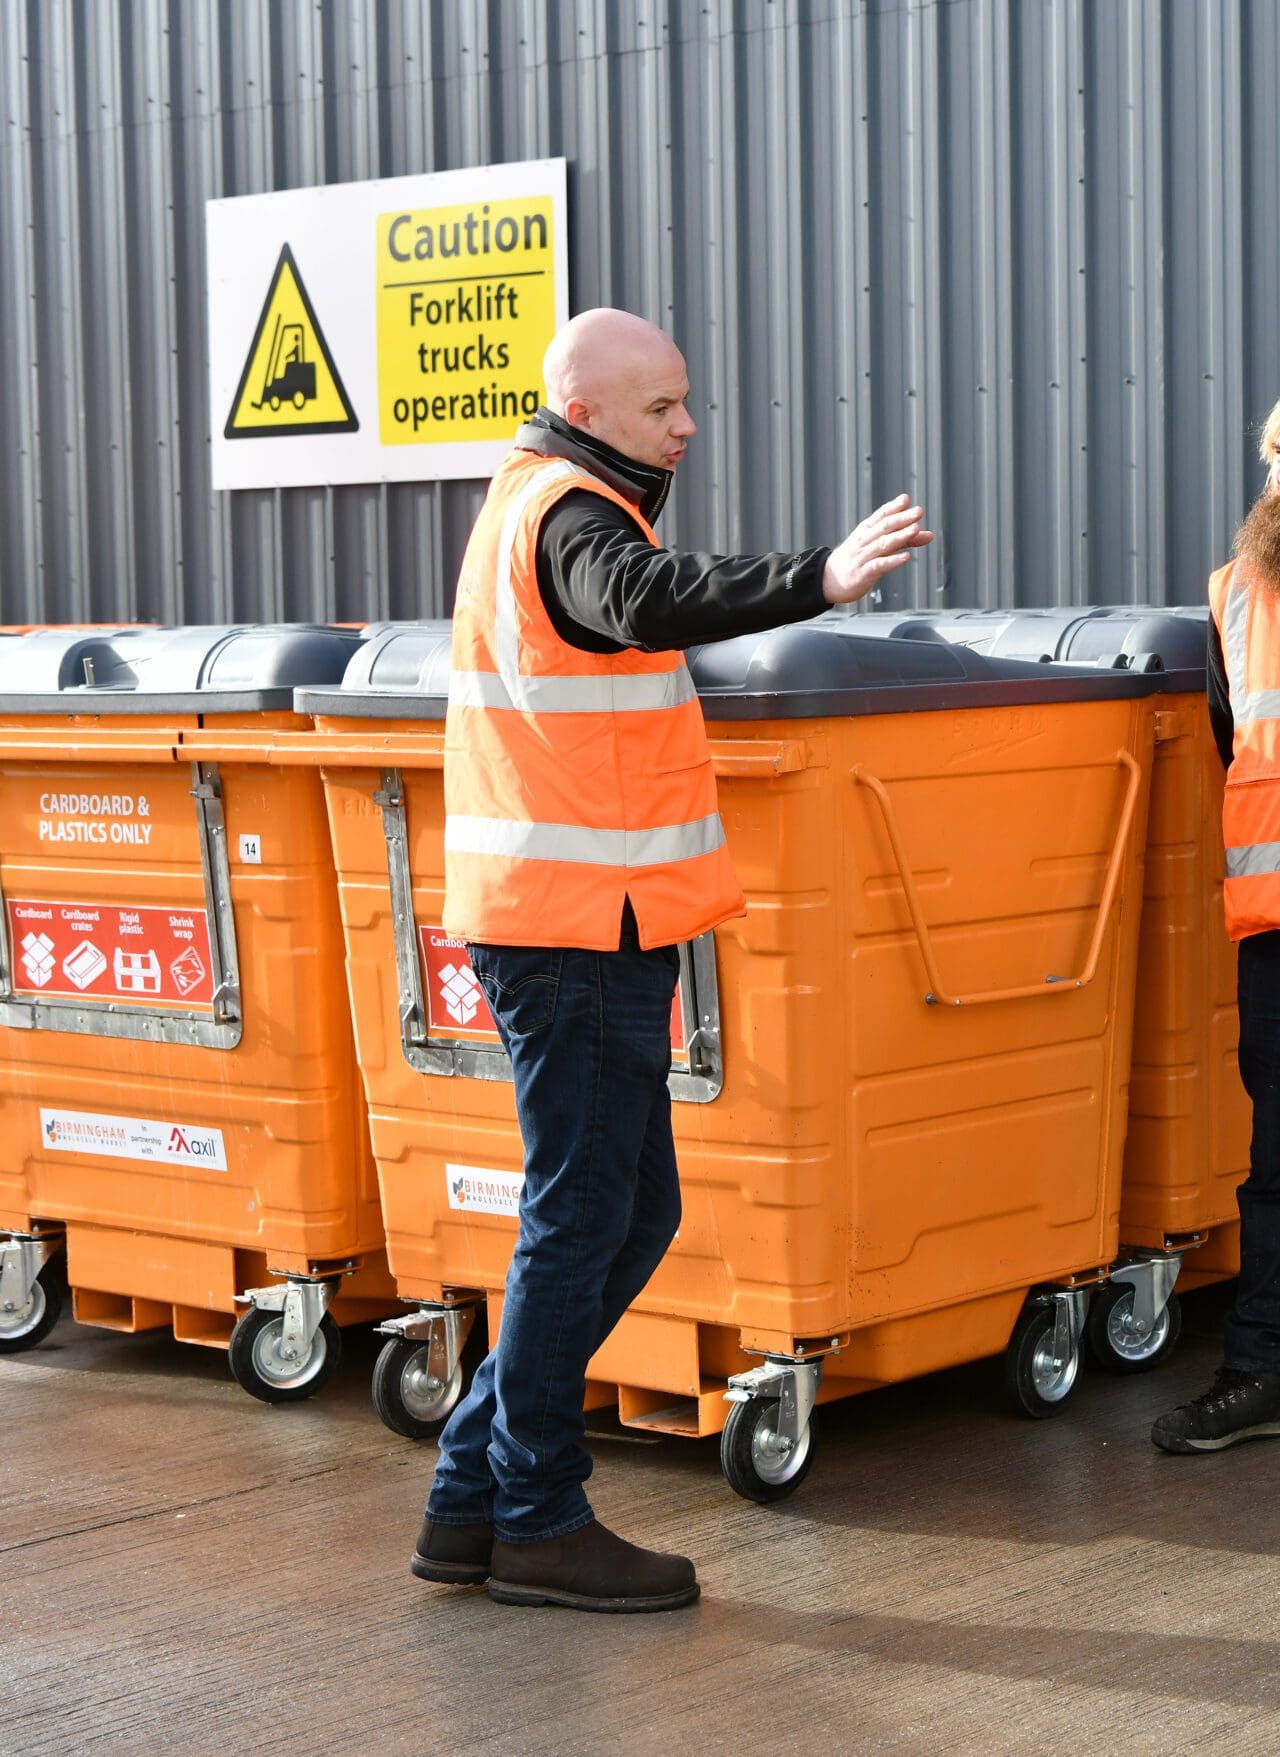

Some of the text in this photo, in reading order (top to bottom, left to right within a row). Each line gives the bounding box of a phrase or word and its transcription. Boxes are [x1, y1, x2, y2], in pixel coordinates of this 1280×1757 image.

[388, 205, 548, 263] Caution
[410, 283, 518, 326] Forklift
[418, 334, 510, 374] trucks
[393, 382, 539, 432] operating
[39, 793, 150, 816] CARDBOARD &
[39, 820, 152, 845] PLASTICS ONLY
[244, 842, 256, 856] 14
[15, 907, 53, 919] Cardboard
[61, 908, 100, 921] Cardboard
[119, 911, 140, 925] Rigid
[168, 915, 195, 928] Shrink
[71, 921, 93, 932] crates
[118, 923, 145, 936] plastic
[172, 929, 193, 941] wrap
[55, 1121, 126, 1140] BIRMINGHAM
[190, 1138, 216, 1157] axil
[464, 1179, 519, 1200] BIRMING
